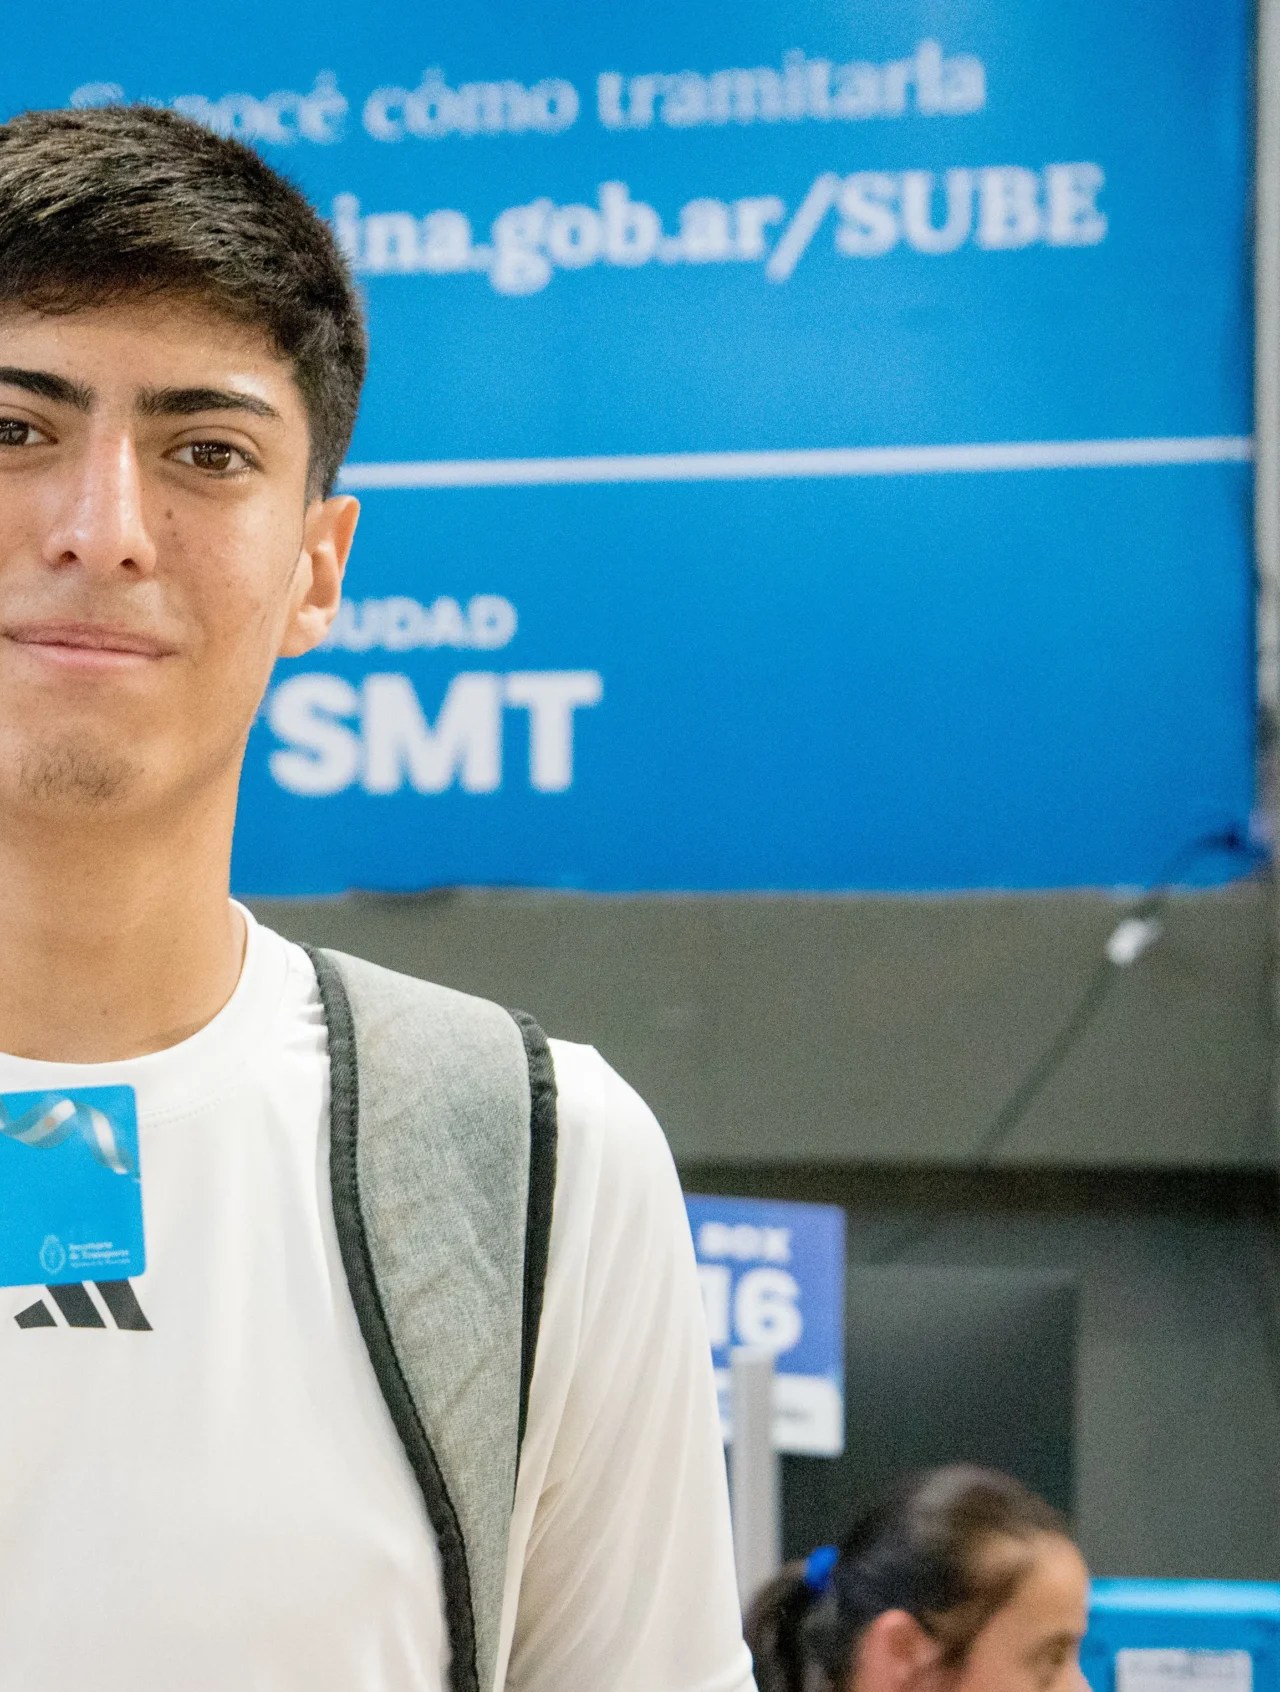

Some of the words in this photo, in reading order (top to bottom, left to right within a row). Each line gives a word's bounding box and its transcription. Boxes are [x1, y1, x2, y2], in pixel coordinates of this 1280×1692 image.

[363, 65, 579, 142] cómo
[597, 38, 986, 130] tramitarla
[332, 161, 1108, 297] ina.gob.ar/SUBE
[268, 670, 604, 796] SMT
[697, 1264, 803, 1353] 16
